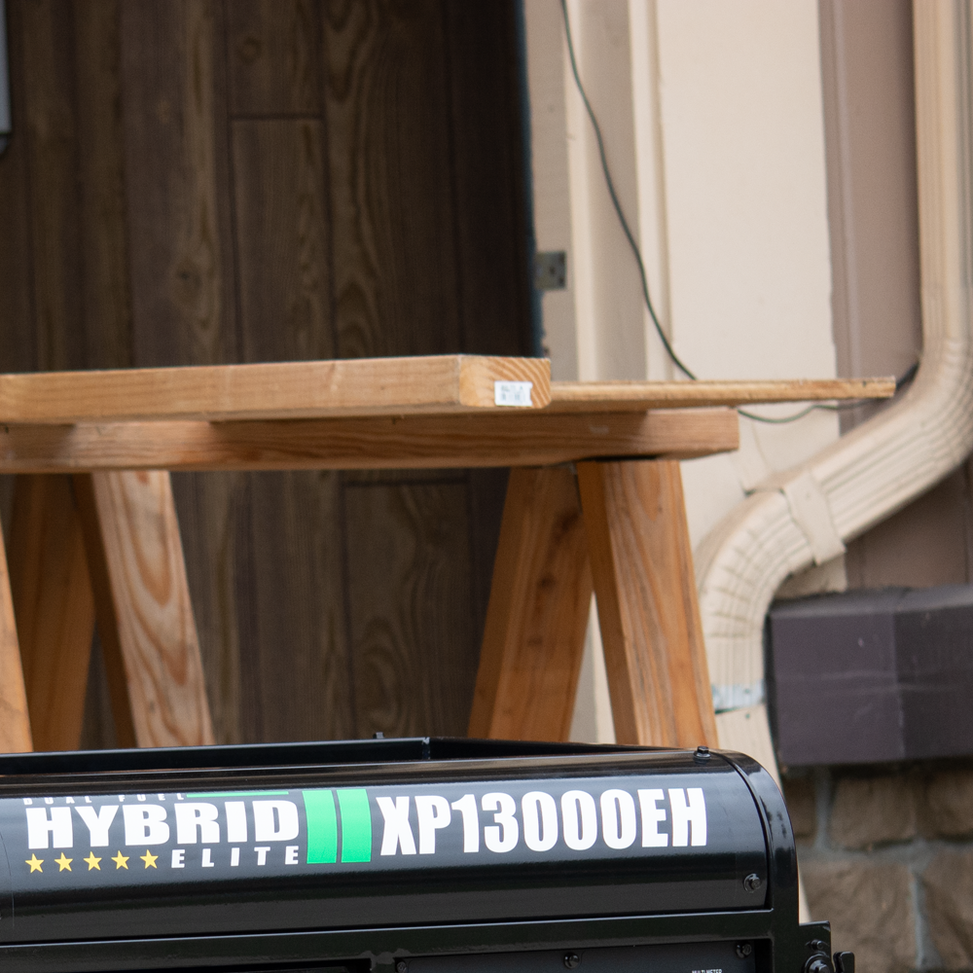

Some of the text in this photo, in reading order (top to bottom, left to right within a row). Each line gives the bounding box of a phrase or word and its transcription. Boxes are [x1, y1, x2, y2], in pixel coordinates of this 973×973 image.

[23, 793, 184, 805] DUAL FUEL
[25, 800, 299, 850] HYBRID
[376, 788, 707, 855] XP13000EH
[171, 846, 299, 868] ELITE
